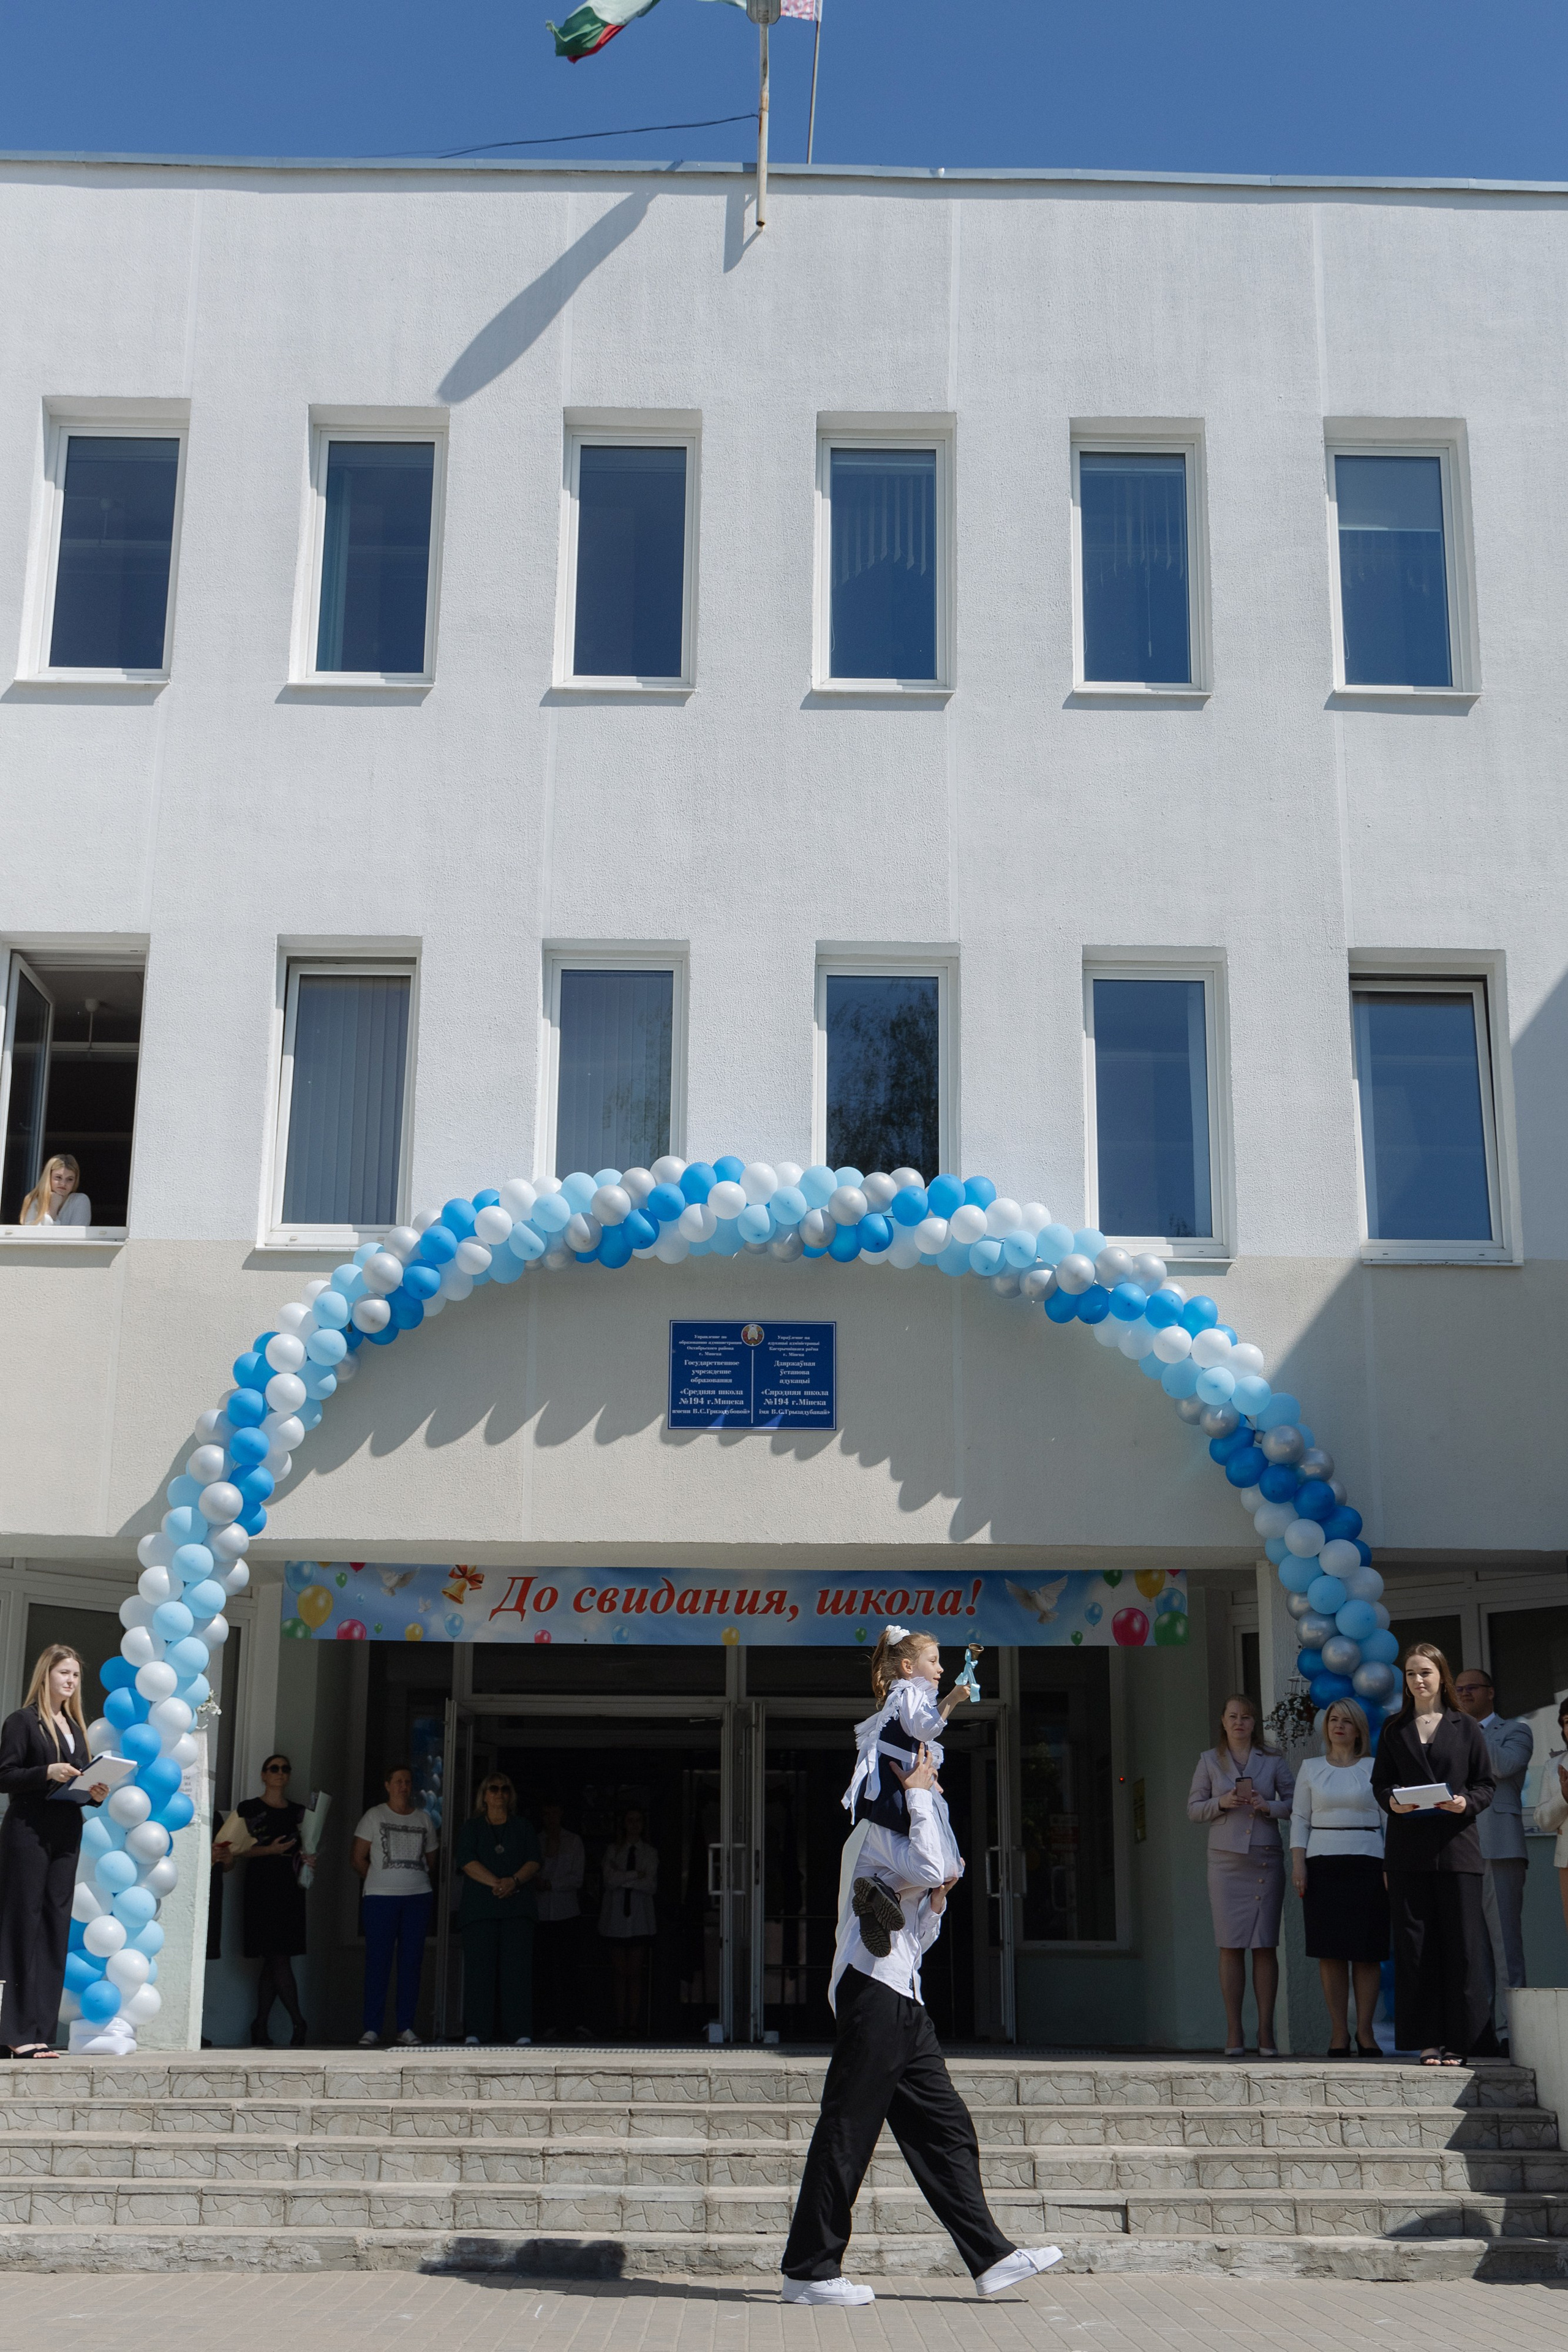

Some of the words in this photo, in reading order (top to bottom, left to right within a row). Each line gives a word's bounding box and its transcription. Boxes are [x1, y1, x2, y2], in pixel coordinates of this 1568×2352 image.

[680, 1388, 715, 1396] «Средняя
[489, 1576, 559, 1622] До
[573, 1577, 799, 1623] свидания,
[816, 1578, 982, 1616] школа!
